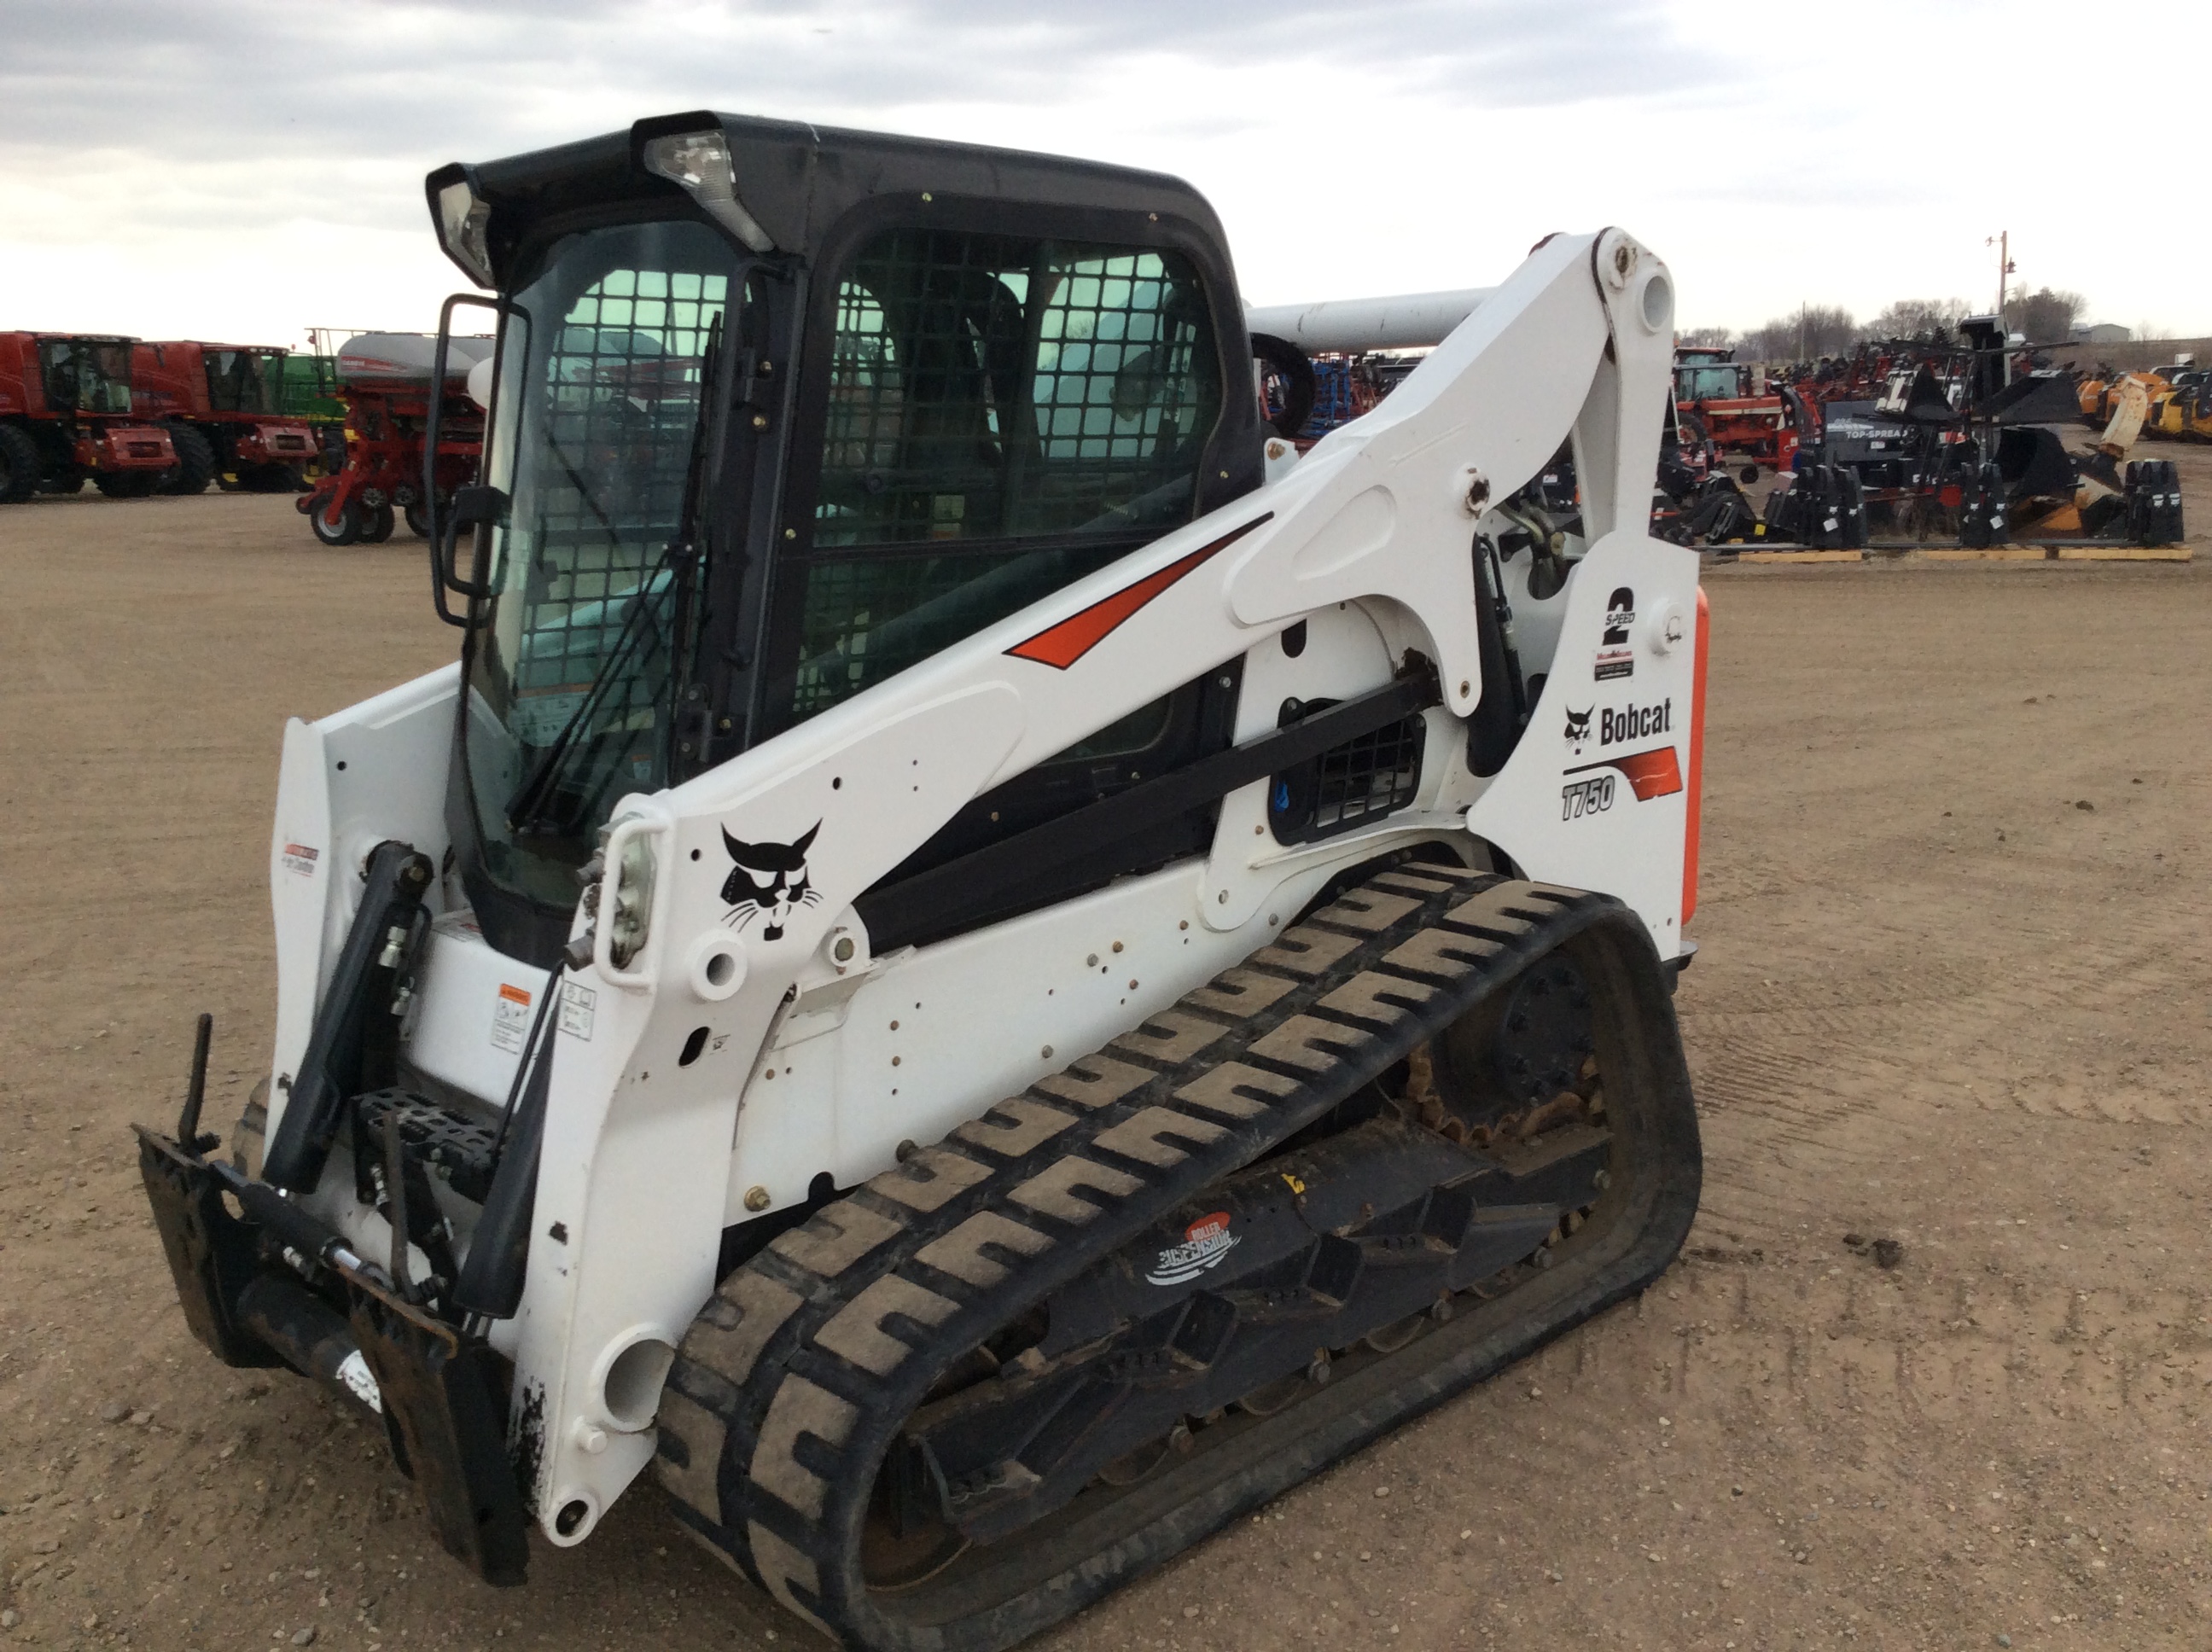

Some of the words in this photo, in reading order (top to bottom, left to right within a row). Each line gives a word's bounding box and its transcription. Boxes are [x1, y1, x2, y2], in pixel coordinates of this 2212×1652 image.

[1605, 612, 1636, 626] SPEED
[1600, 697, 1671, 747] Bobcat
[1563, 775, 1615, 821] T750
[1191, 1222, 1220, 1242] ROLLER
